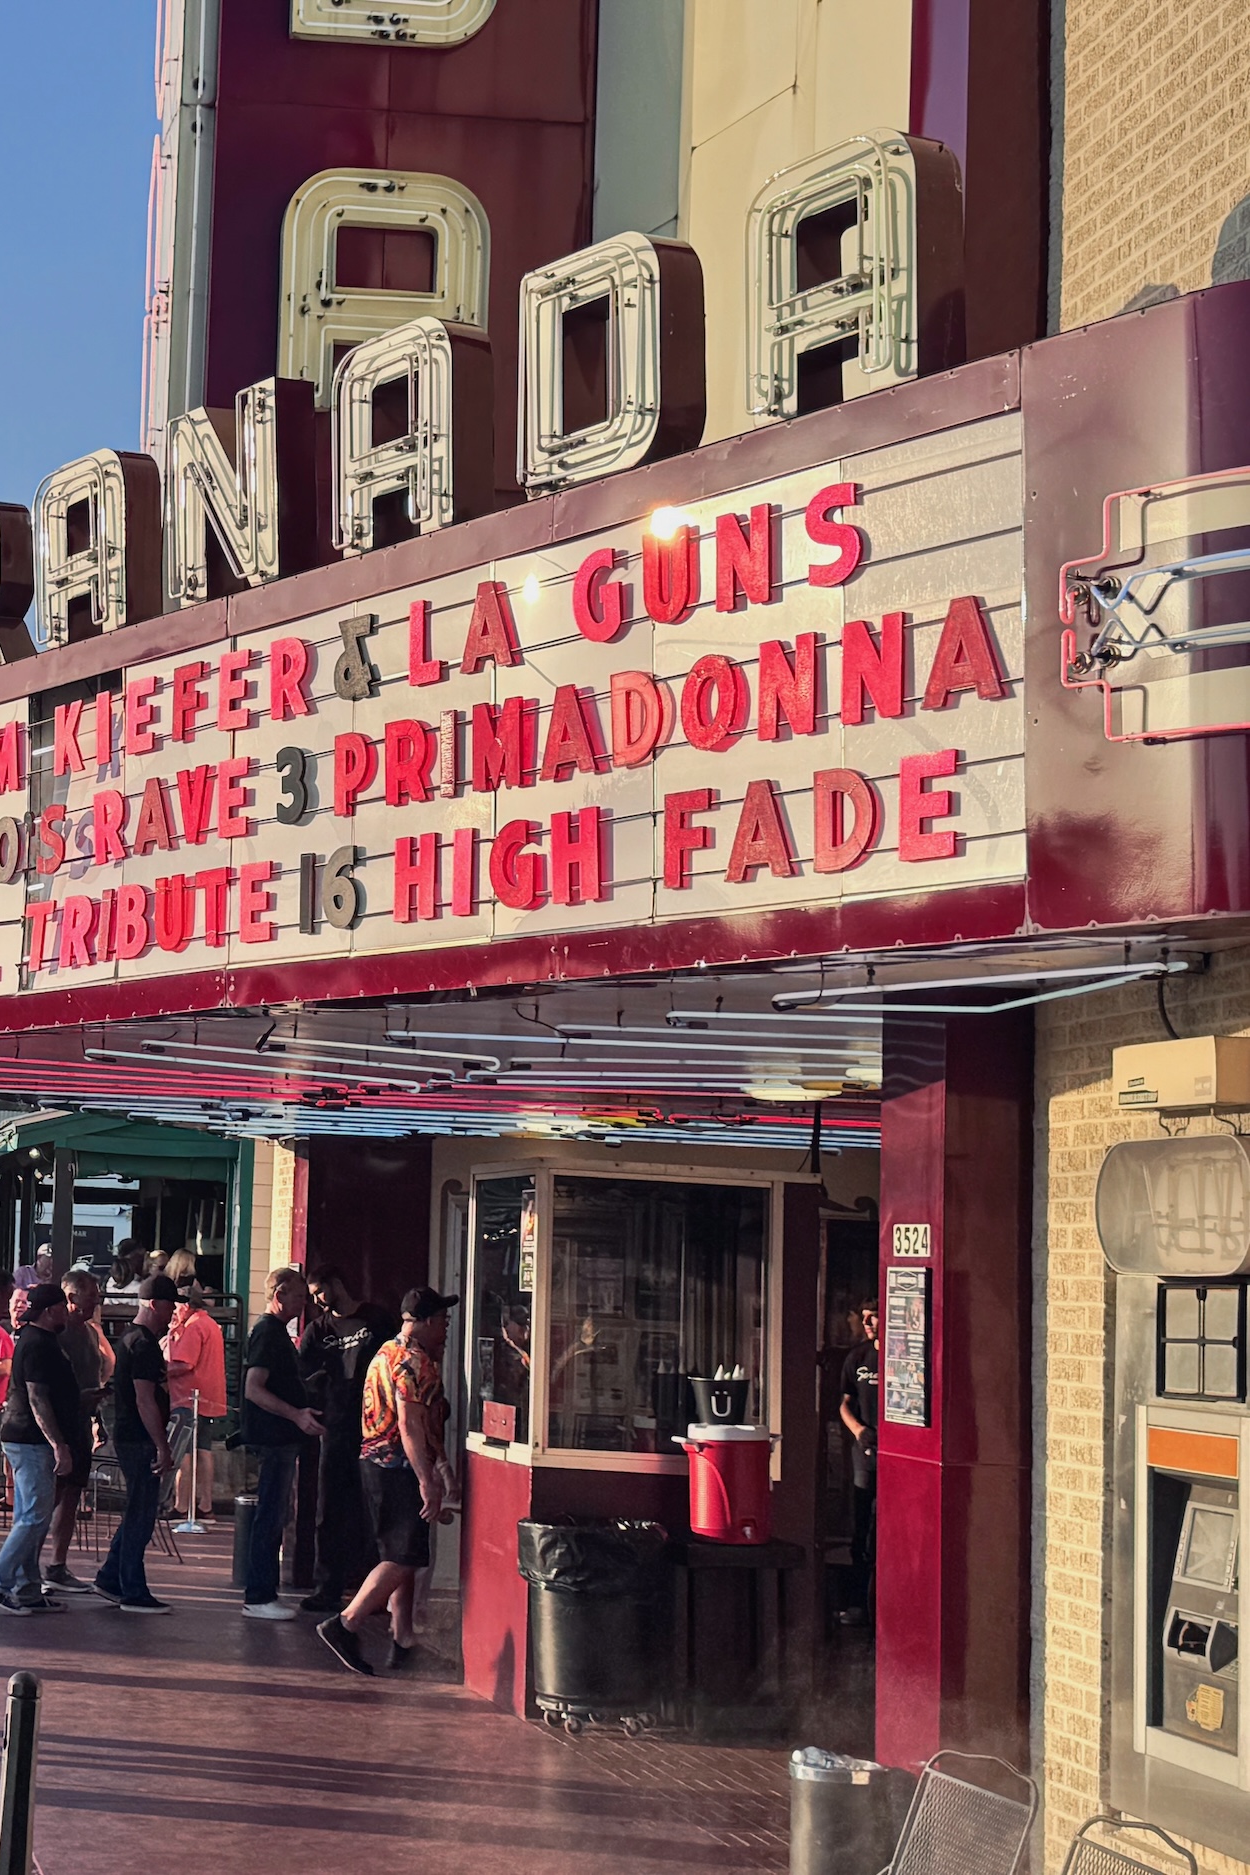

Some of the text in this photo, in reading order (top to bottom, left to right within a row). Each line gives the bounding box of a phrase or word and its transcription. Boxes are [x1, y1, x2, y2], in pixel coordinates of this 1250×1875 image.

[54, 637, 309, 777] KIEFER
[407, 581, 520, 686] LA
[572, 482, 866, 645] GUNS
[93, 757, 250, 866] RAVE
[276, 747, 308, 824] 3
[334, 595, 1008, 817] PRIMADONNA
[25, 860, 274, 973] TRIBUTE
[299, 845, 367, 934] 16
[393, 806, 612, 924] HIGH
[662, 749, 960, 891] FADE
[895, 1226, 929, 1255] 3524
